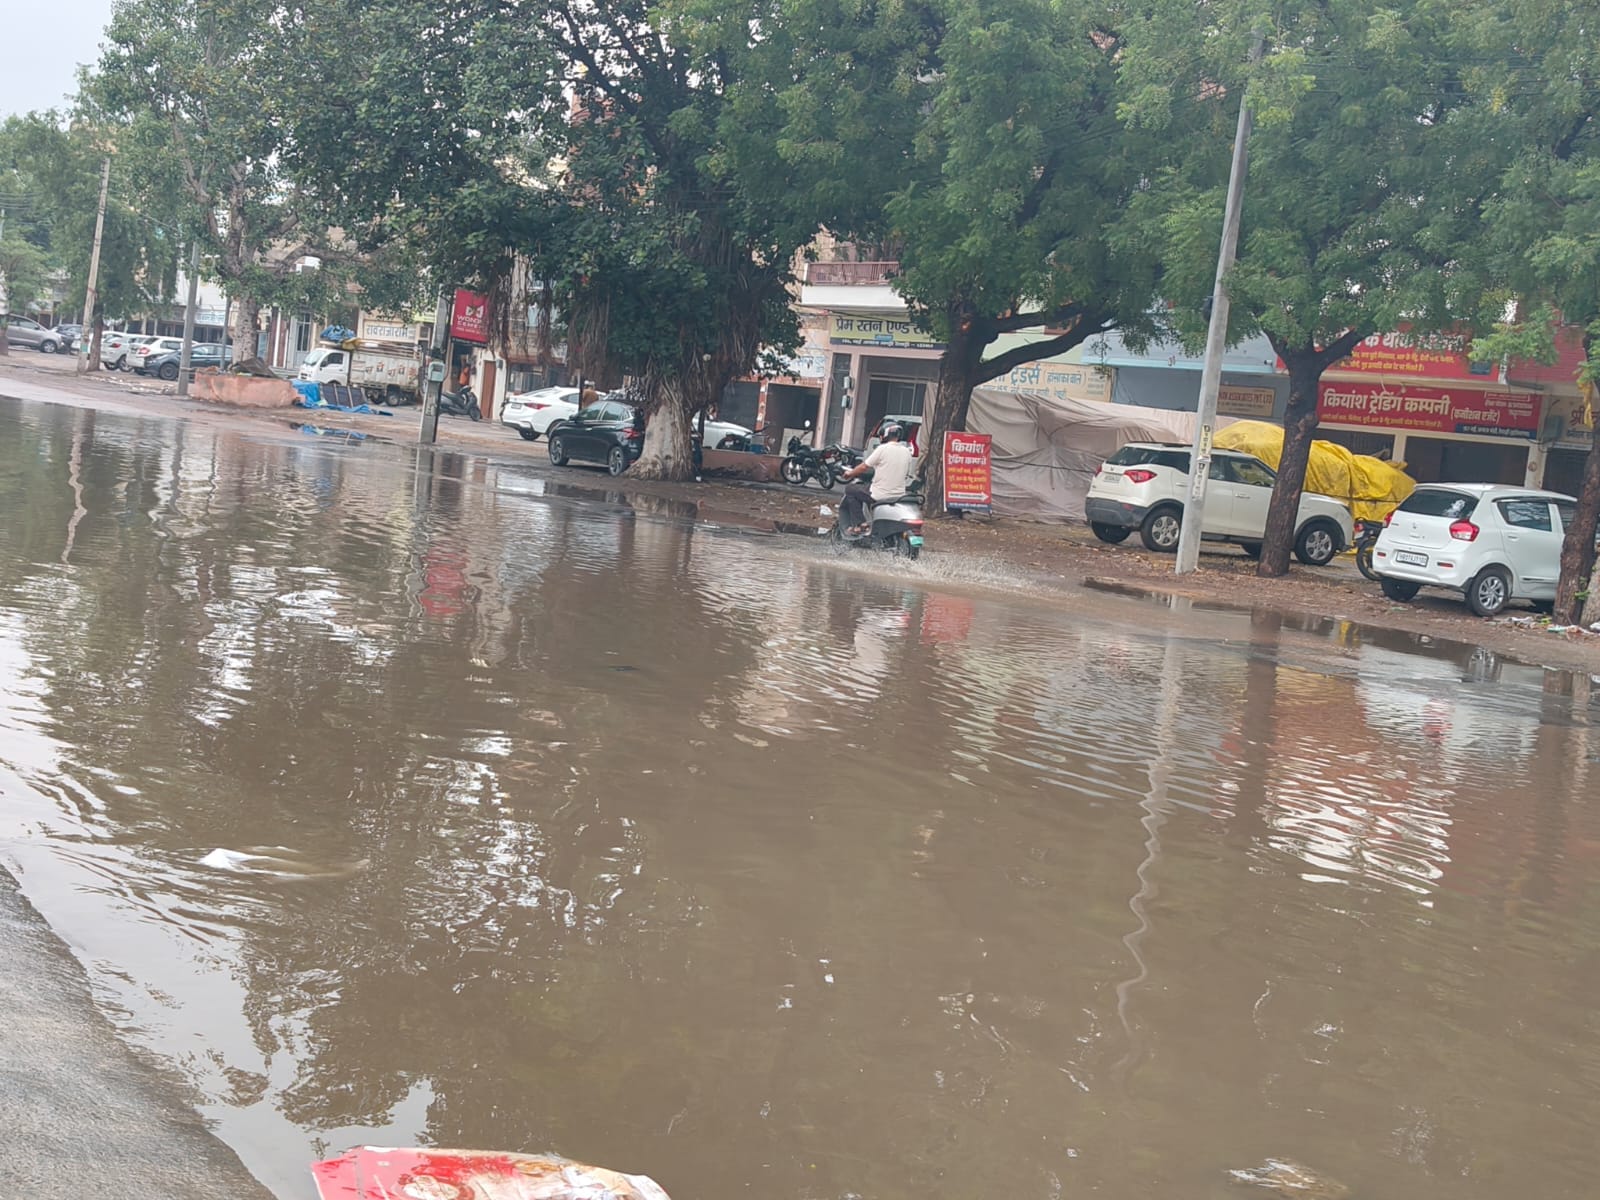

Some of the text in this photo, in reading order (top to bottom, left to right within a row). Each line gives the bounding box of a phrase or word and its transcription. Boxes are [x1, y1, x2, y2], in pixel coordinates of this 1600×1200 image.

[836, 315, 853, 332] प्रेम
[857, 319, 882, 333] रतन
[1323, 388, 1368, 409] कियांश
[1404, 394, 1451, 415] कम्पनी
[951, 439, 985, 454] कियांश
